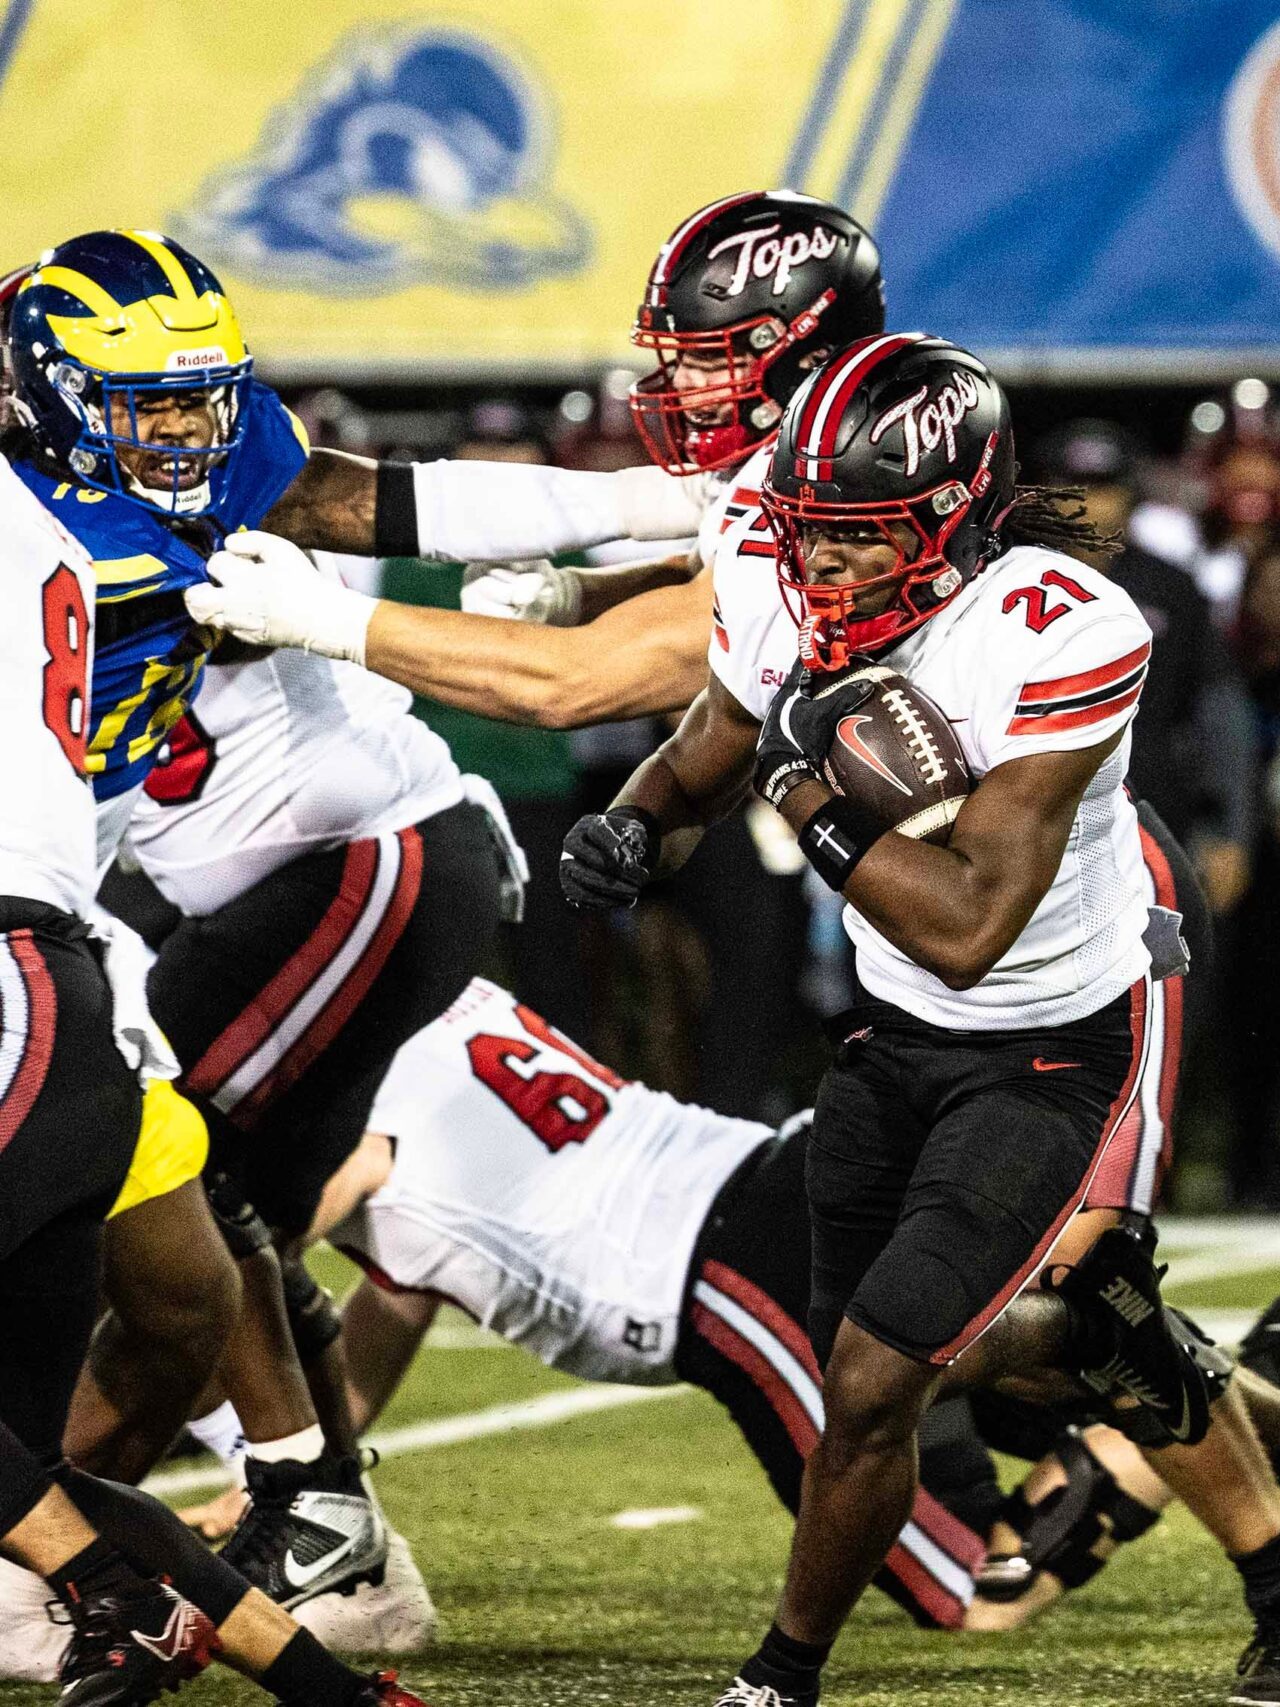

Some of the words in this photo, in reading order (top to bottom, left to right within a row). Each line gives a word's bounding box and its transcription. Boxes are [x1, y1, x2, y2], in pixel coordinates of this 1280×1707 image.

[706, 223, 838, 297] Tops
[176, 353, 224, 367] Riddell
[869, 370, 979, 478] Tops
[1001, 569, 1100, 635] 21
[1099, 1275, 1155, 1328] NIKE
